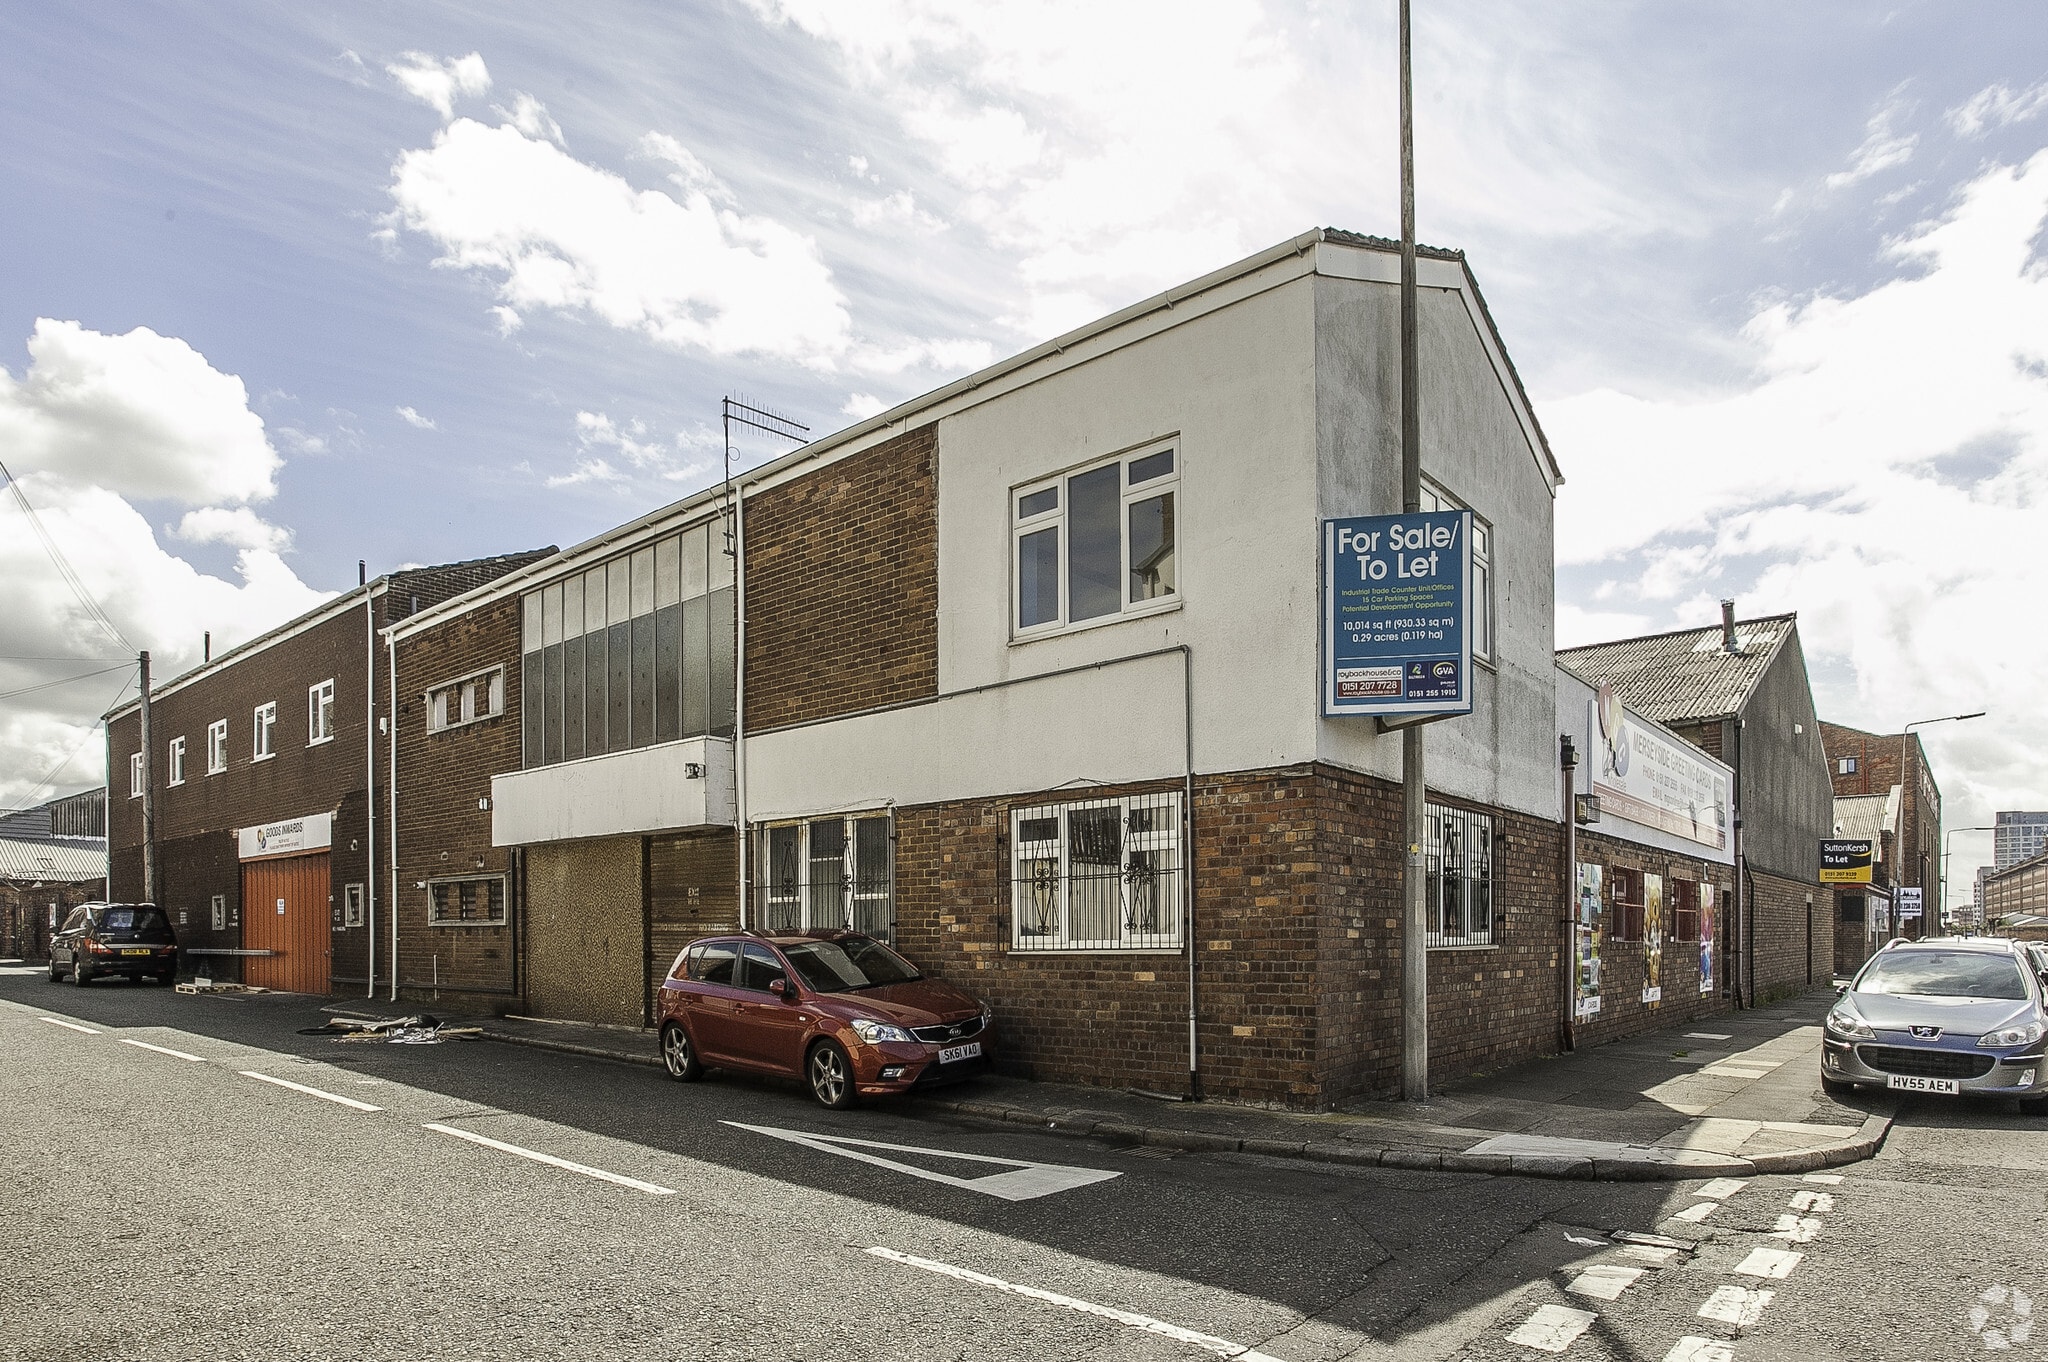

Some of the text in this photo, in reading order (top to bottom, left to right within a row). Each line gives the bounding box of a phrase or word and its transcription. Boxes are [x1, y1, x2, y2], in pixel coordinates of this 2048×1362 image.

[1338, 520, 1460, 554] For Sale/
[1356, 550, 1438, 580] To Let
[1391, 585, 1417, 593] Counter
[1384, 594, 1408, 603] Parking
[1410, 594, 1434, 602] Spaces
[1371, 604, 1413, 612] Development
[1415, 601, 1454, 610] Opportunity
[1343, 616, 1454, 631] 10,014 sq ft (930.33 sq m)
[1352, 630, 1443, 642] 0.29 acres (0.119 ha)
[1436, 666, 1454, 675] GVA
[1342, 681, 1398, 691] 0151 207 7728
[1633, 731, 1712, 790] MERSEYSIDE GREETING CARDS
[266, 822, 302, 838] GOODS INWARDS
[1824, 844, 1868, 852] SuttonKersh
[944, 1047, 962, 1060] SK61
[1893, 1076, 1953, 1091] HV55 AEM
